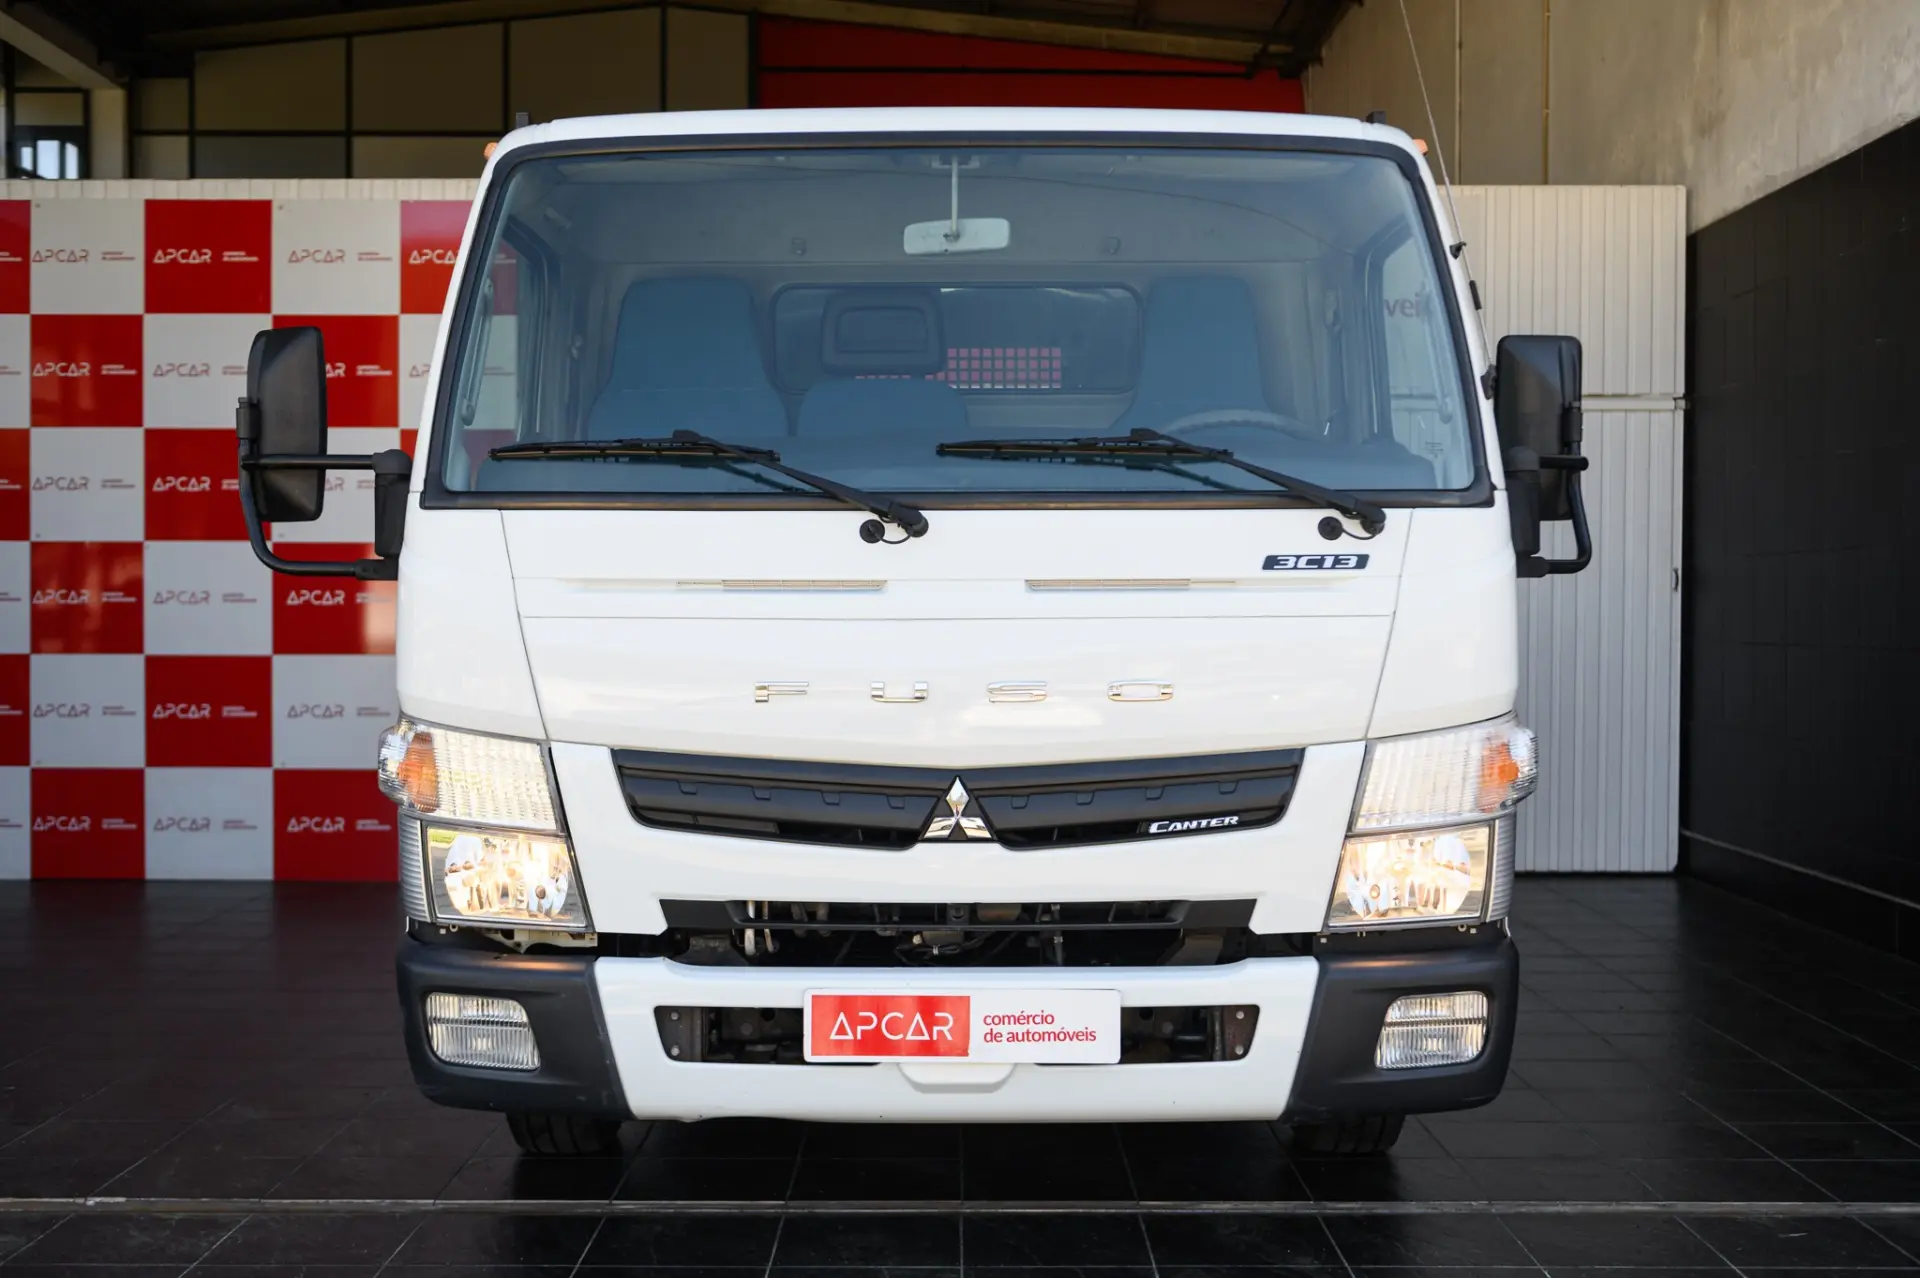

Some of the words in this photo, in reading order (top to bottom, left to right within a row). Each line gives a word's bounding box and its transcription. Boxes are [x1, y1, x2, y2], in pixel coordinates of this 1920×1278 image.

[32, 249, 89, 264] APCAR
[153, 249, 212, 264] APCAR
[288, 249, 345, 264] APCAR
[409, 249, 458, 264] APCA
[32, 362, 90, 377] APCAR
[153, 363, 210, 378] APCAR
[32, 476, 89, 491] APCAR
[152, 476, 211, 492] APCAR
[1273, 555, 1359, 569] 3C13
[32, 590, 90, 605] APCAR
[152, 590, 210, 605] APCAR
[286, 590, 345, 605] APCAR
[755, 681, 1174, 702] FUSO
[33, 703, 91, 718] APCAR
[152, 703, 211, 718] APCAR
[287, 704, 344, 718] APCAR
[32, 816, 91, 831] APCAR
[153, 817, 210, 832] APCAR
[287, 816, 344, 832] APCAR
[983, 1010, 1055, 1025] comércio
[829, 1011, 953, 1041] APCAR
[983, 1028, 1002, 1043] de
[1006, 1027, 1097, 1042] automóveis
